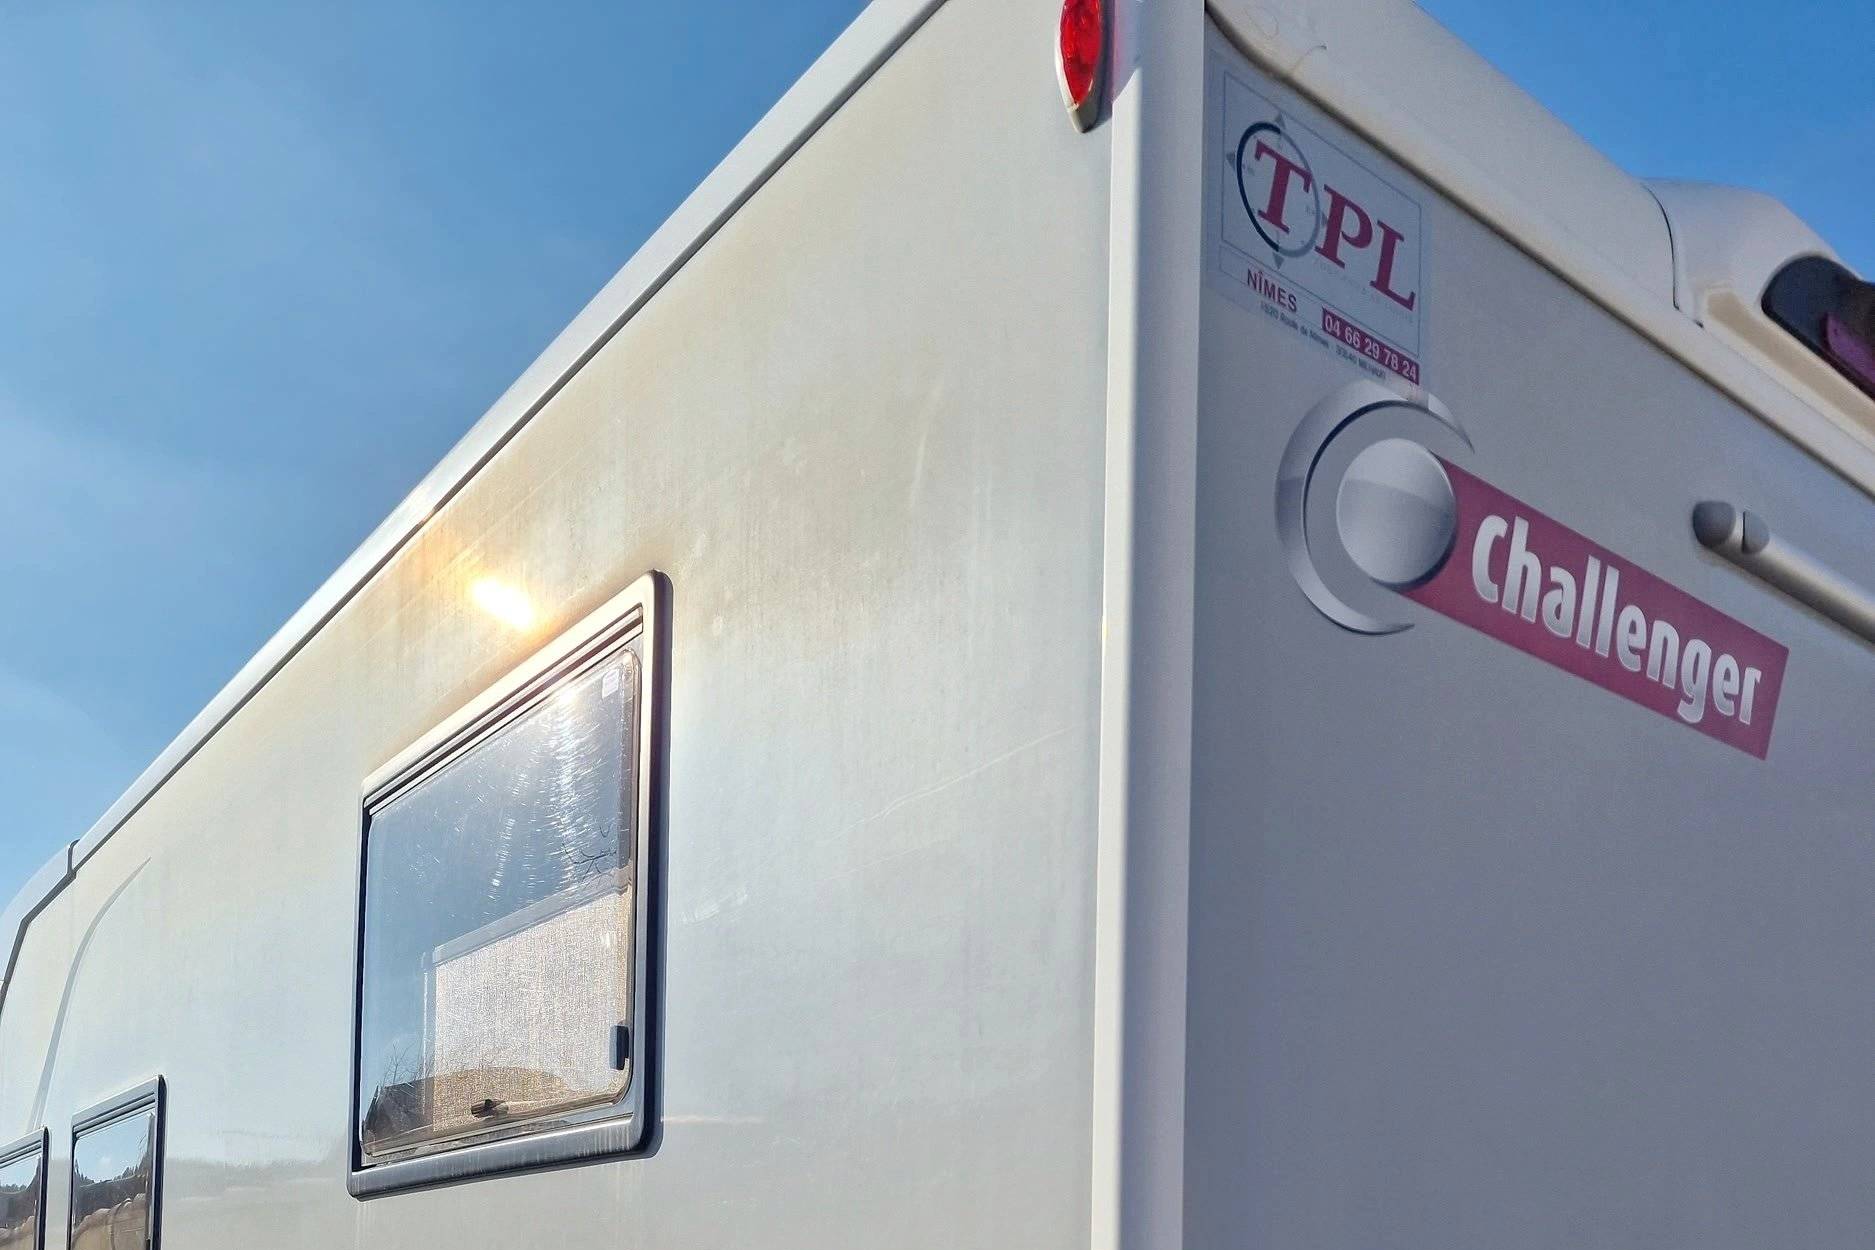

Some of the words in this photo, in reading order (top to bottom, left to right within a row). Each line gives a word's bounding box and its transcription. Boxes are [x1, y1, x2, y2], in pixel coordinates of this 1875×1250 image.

[1254, 140, 1416, 311] TPL
[1247, 269, 1298, 312] NÎMES
[1324, 314, 1341, 337] 04
[1344, 326, 1361, 348] 66
[1364, 337, 1381, 358] 29
[1383, 349, 1399, 369] 78
[1402, 359, 1417, 380] 24
[1472, 515, 1762, 723] Challenger
